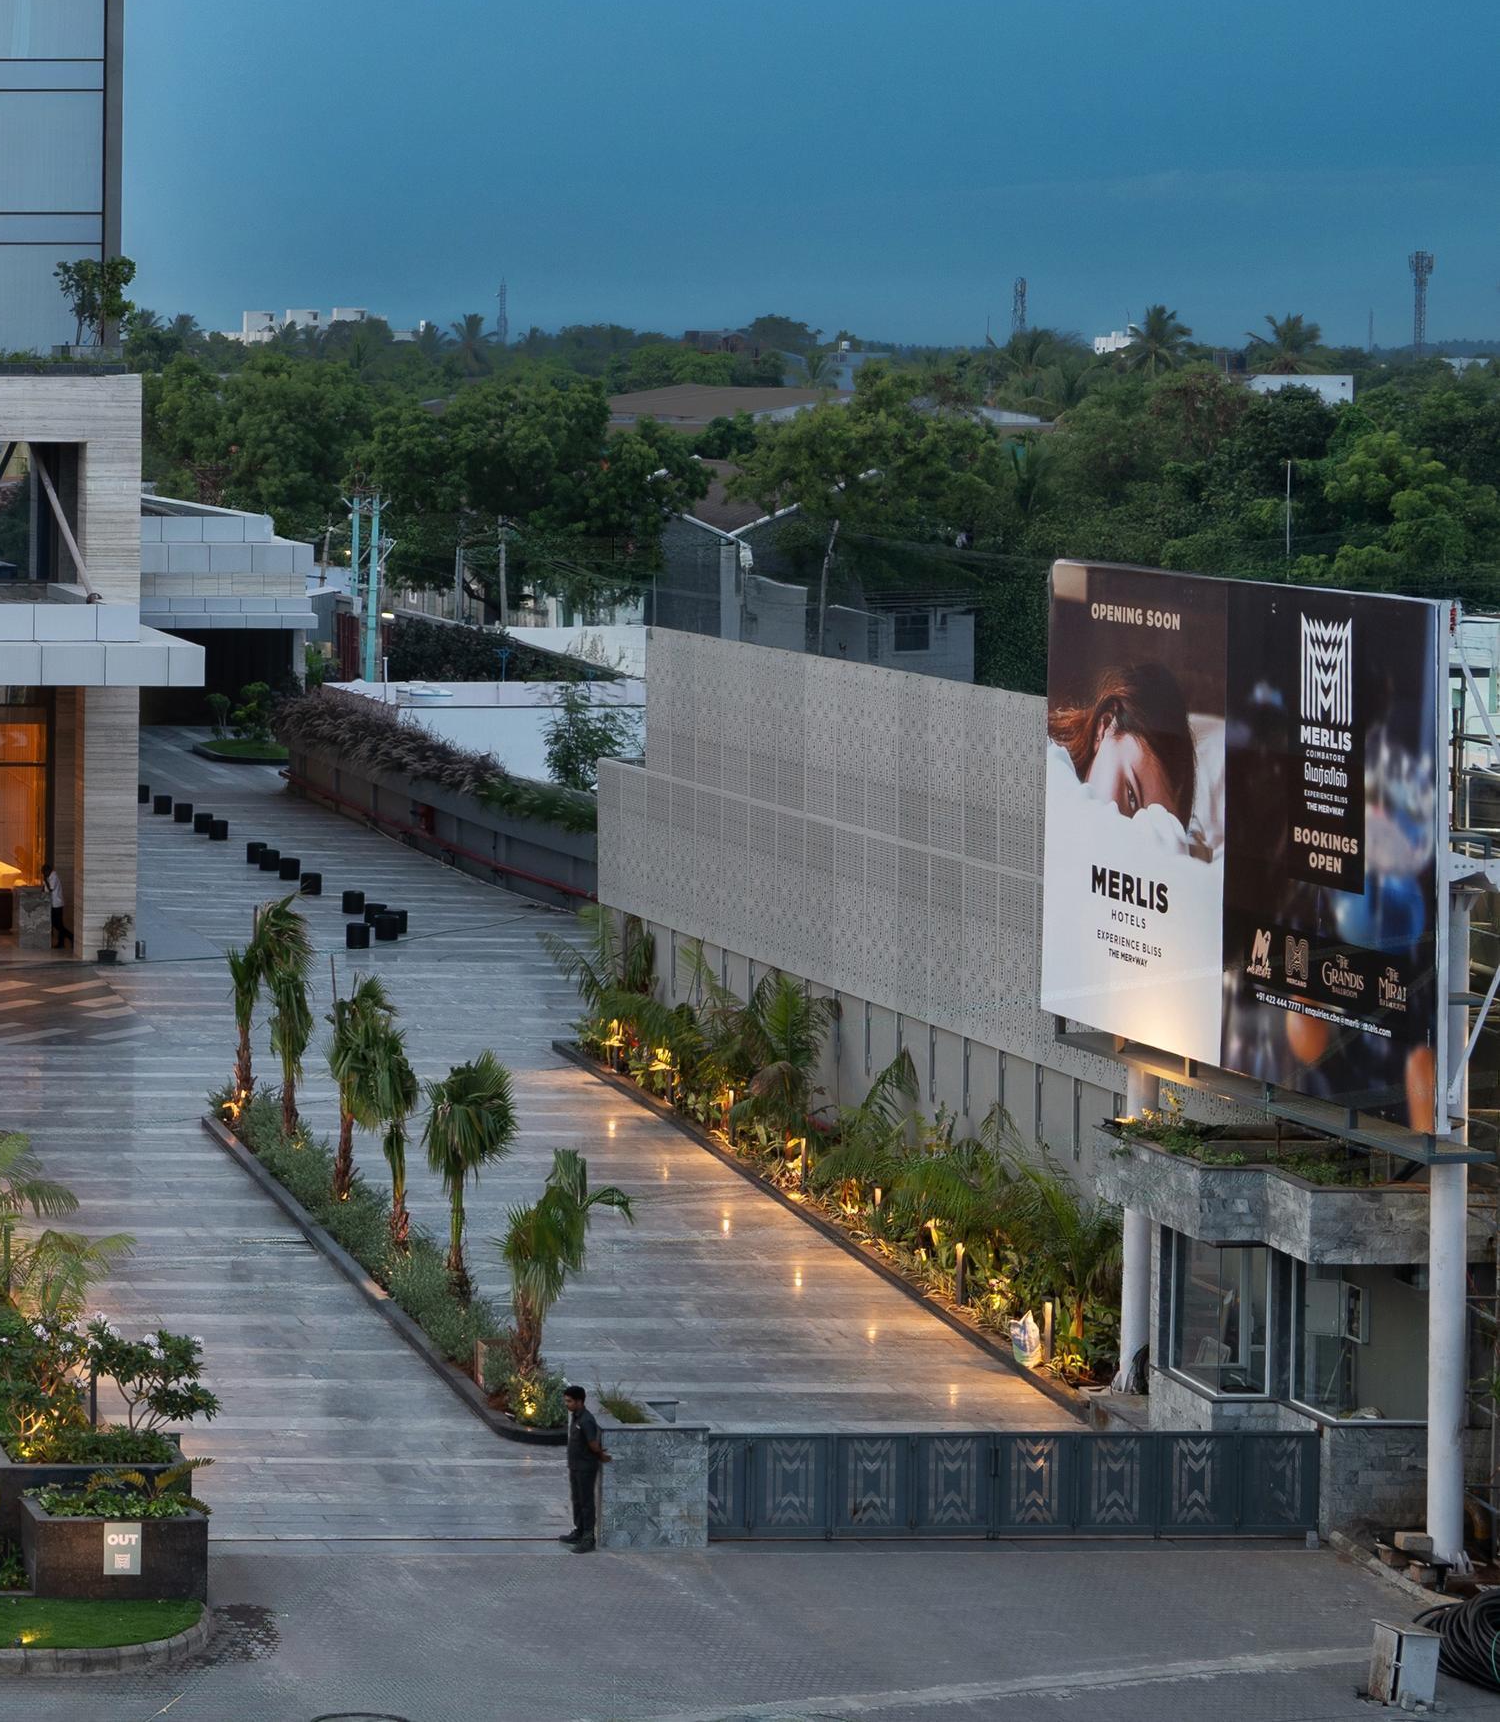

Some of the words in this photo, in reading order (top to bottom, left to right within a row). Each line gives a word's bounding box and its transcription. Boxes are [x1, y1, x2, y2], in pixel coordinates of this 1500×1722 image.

[1090, 602, 1143, 625] OPENING
[1146, 609, 1180, 631] SOON
[1299, 724, 1353, 752] MERLIS
[1305, 749, 1346, 764] COIMBATORE
[1303, 789, 1333, 801] EXPERIENCE
[1306, 801, 1318, 811] THE
[1294, 826, 1358, 855] BOOKINGS
[1308, 851, 1342, 874] OPEN
[1091, 864, 1169, 914] MERLIS
[1111, 909, 1147, 930] HOTELS
[1096, 929, 1140, 951] EXPERIENCE
[1142, 942, 1162, 958] BLISS
[1108, 948, 1120, 959] THE
[1321, 961, 1365, 991] GRANDIS
[1265, 994, 1276, 1005] 422
[1276, 997, 1287, 1008] 444
[1288, 1000, 1301, 1012] 7777
[107, 1533, 139, 1546] OUT
